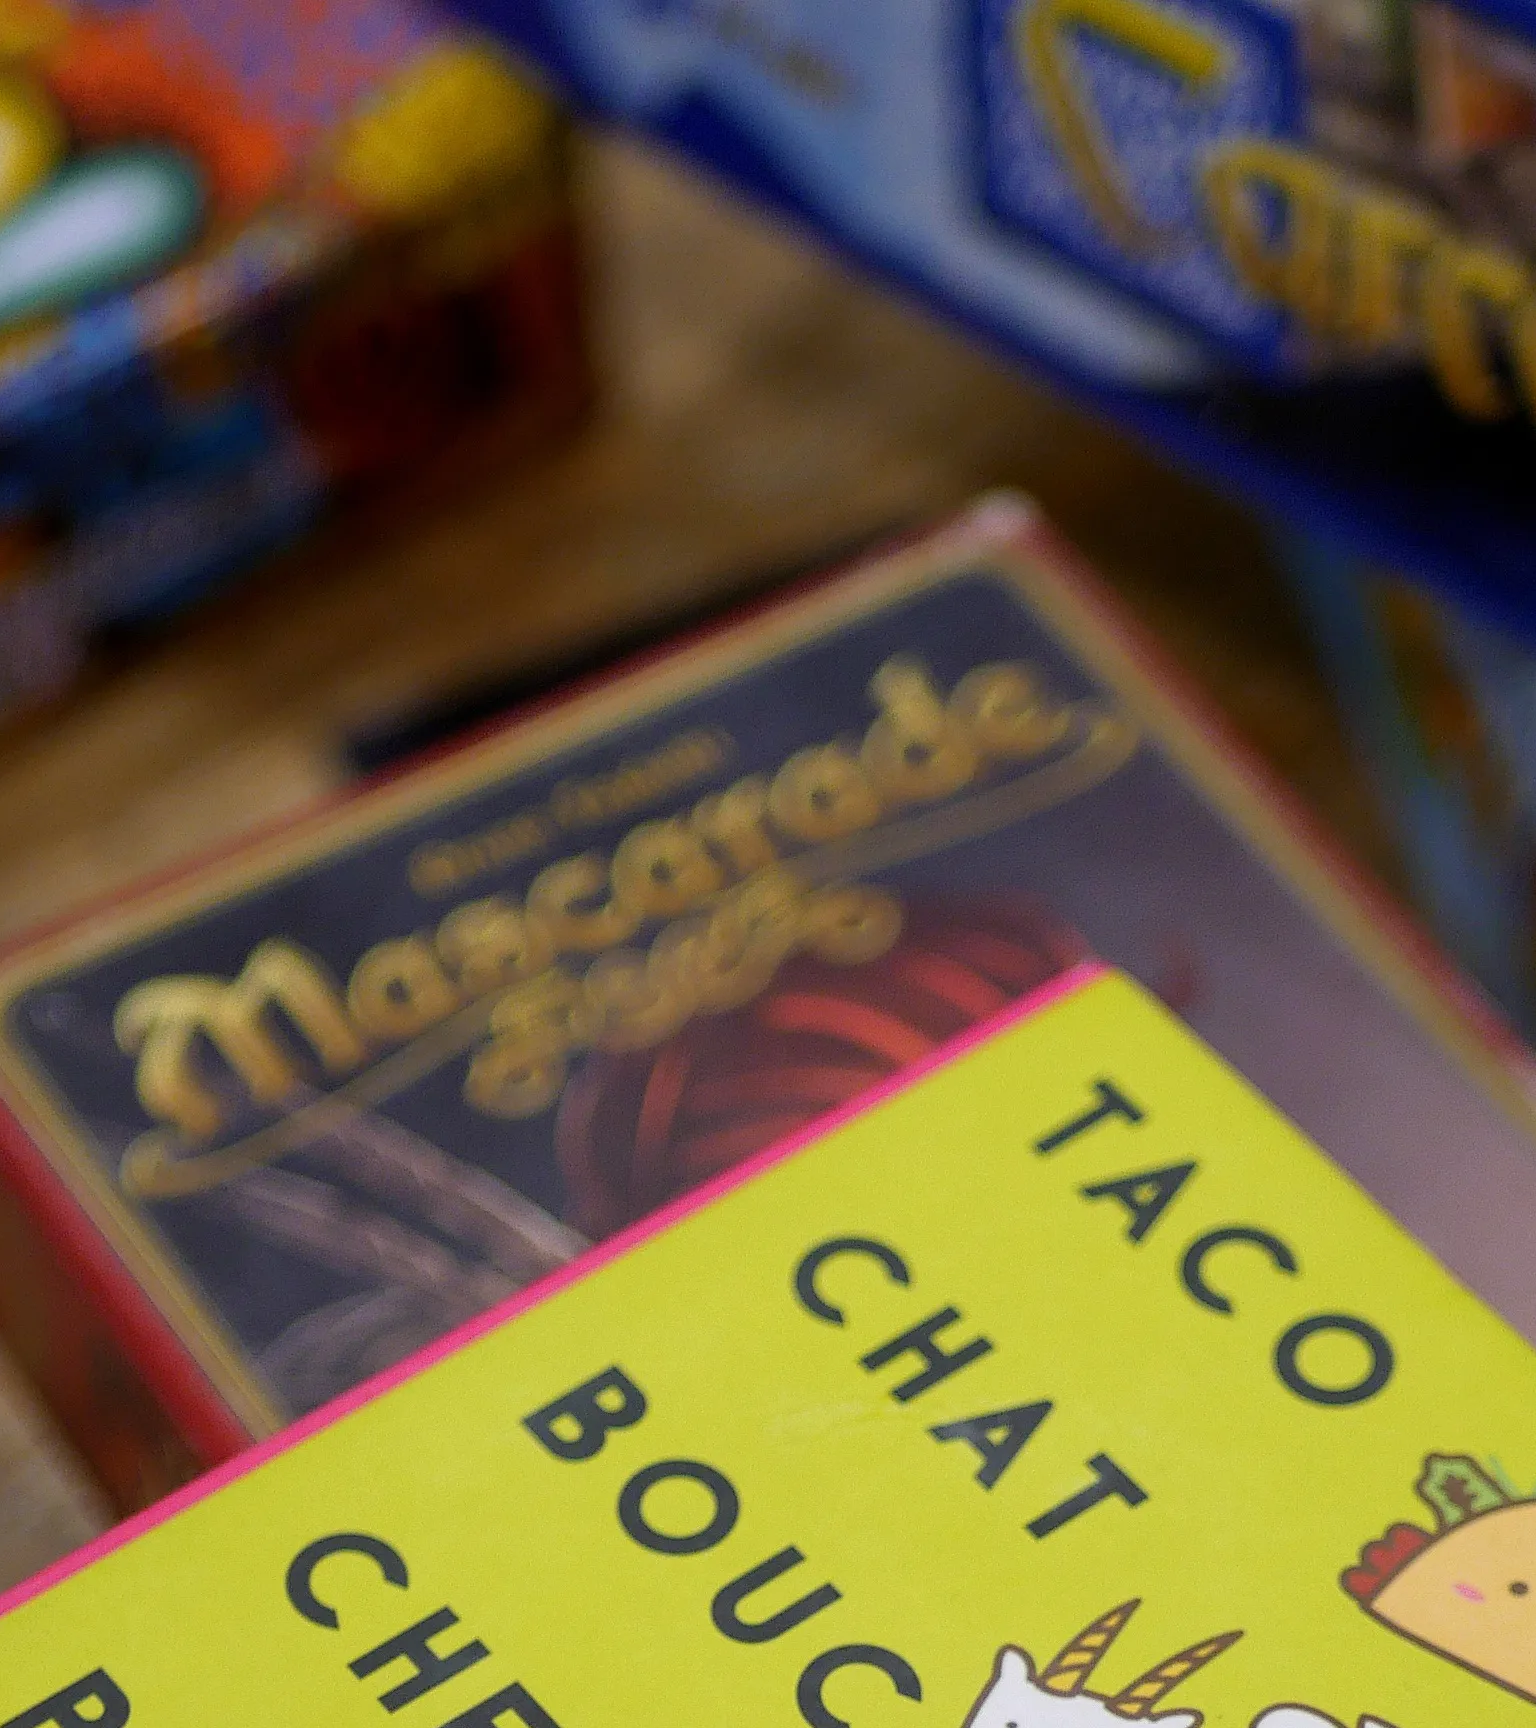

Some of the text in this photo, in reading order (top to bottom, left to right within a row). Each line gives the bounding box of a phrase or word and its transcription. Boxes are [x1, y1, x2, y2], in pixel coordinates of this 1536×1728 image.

[114, 652, 1069, 1141] Mascarade
[793, 1235, 1150, 1540] CHAT
[1032, 1077, 1394, 1406] TACO
